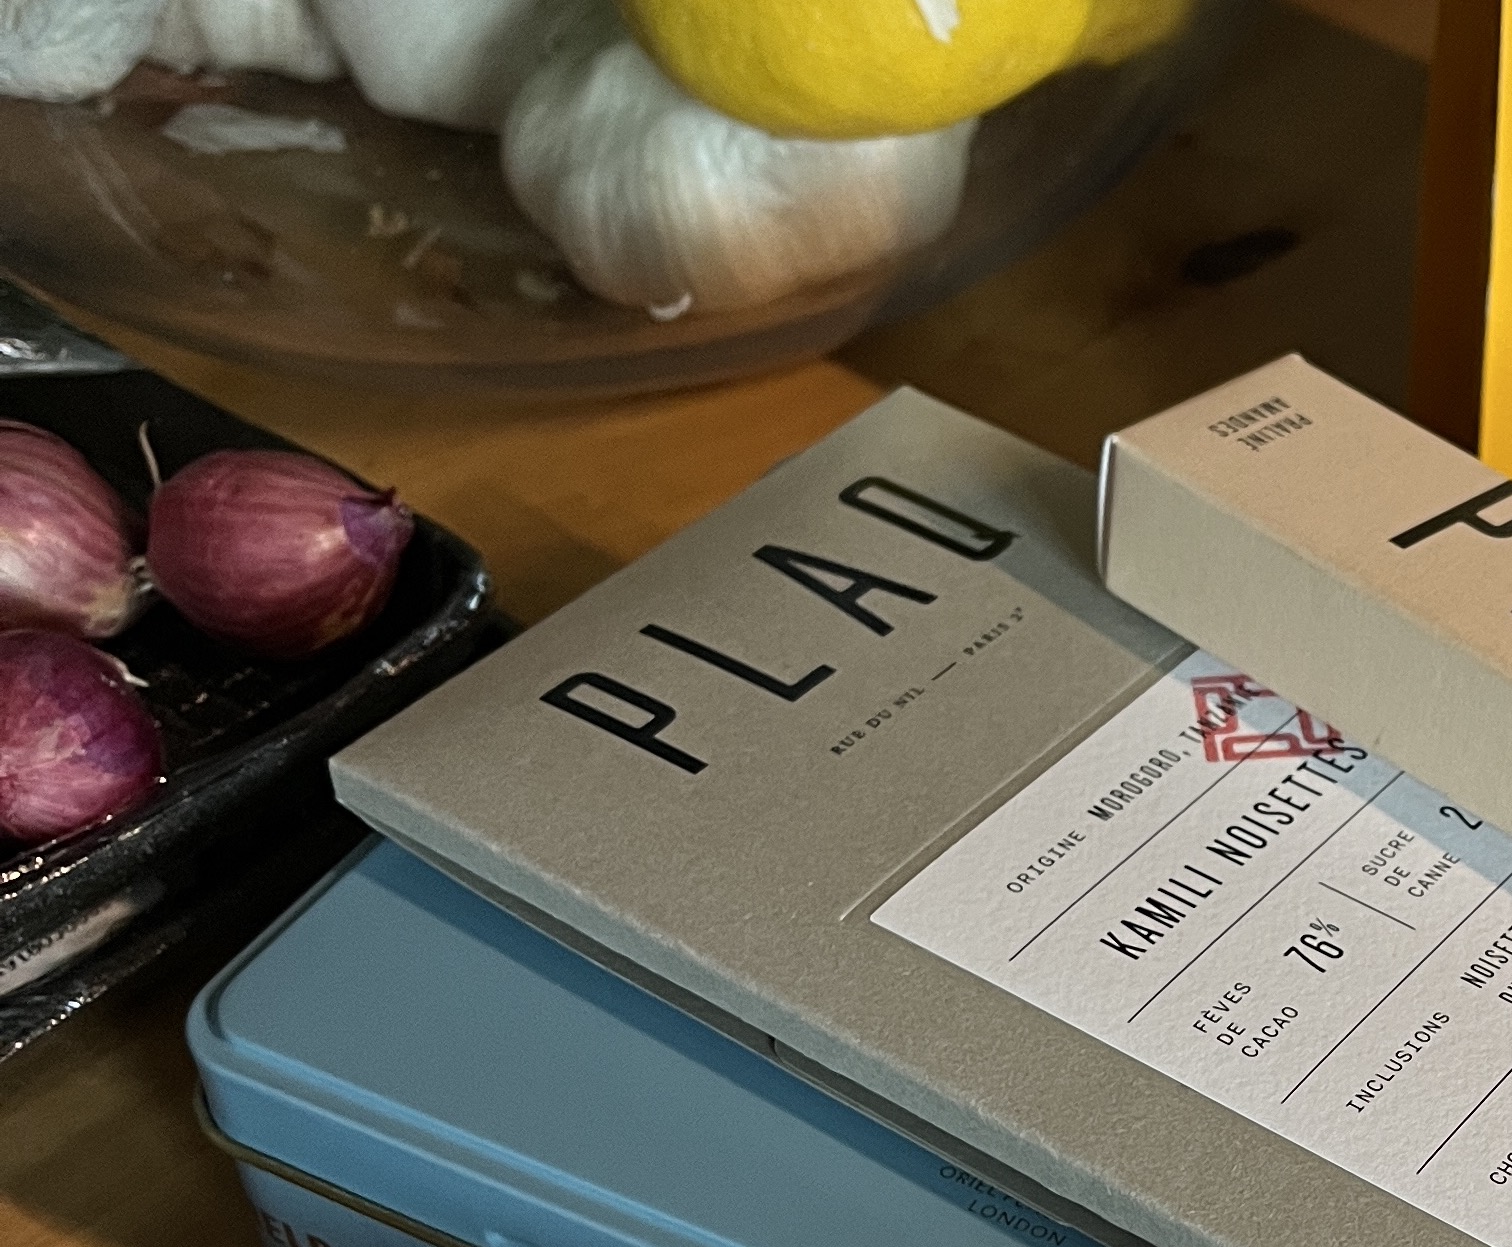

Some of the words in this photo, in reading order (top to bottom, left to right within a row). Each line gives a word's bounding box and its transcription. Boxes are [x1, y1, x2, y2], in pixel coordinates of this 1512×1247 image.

[1208, 396, 1290, 439] AMANDES
[1237, 413, 1314, 453] PRALINE
[538, 476, 1022, 775] PLAQ
[831, 727, 867, 757] RUE
[865, 708, 892, 731] DU
[894, 683, 926, 711] NIL
[962, 624, 1010, 657] PARIS
[1006, 830, 1086, 895] ORIGINE
[1086, 747, 1191, 823] MOROGORO,
[1100, 860, 1224, 962] KAMILI
[1205, 737, 1370, 869] NOISETTES
[1361, 830, 1416, 877] SUCRE
[1383, 864, 1411, 889] DE
[1407, 850, 1461, 899] CANNE
[1283, 916, 1345, 974] 76%
[1192, 981, 1253, 1036] FÈVES
[1216, 1021, 1246, 1048] DE
[1241, 1005, 1299, 1061] CACAO
[1346, 1009, 1451, 1114] INCLUSIONS
[967, 1200, 1068, 1247] LONDON
